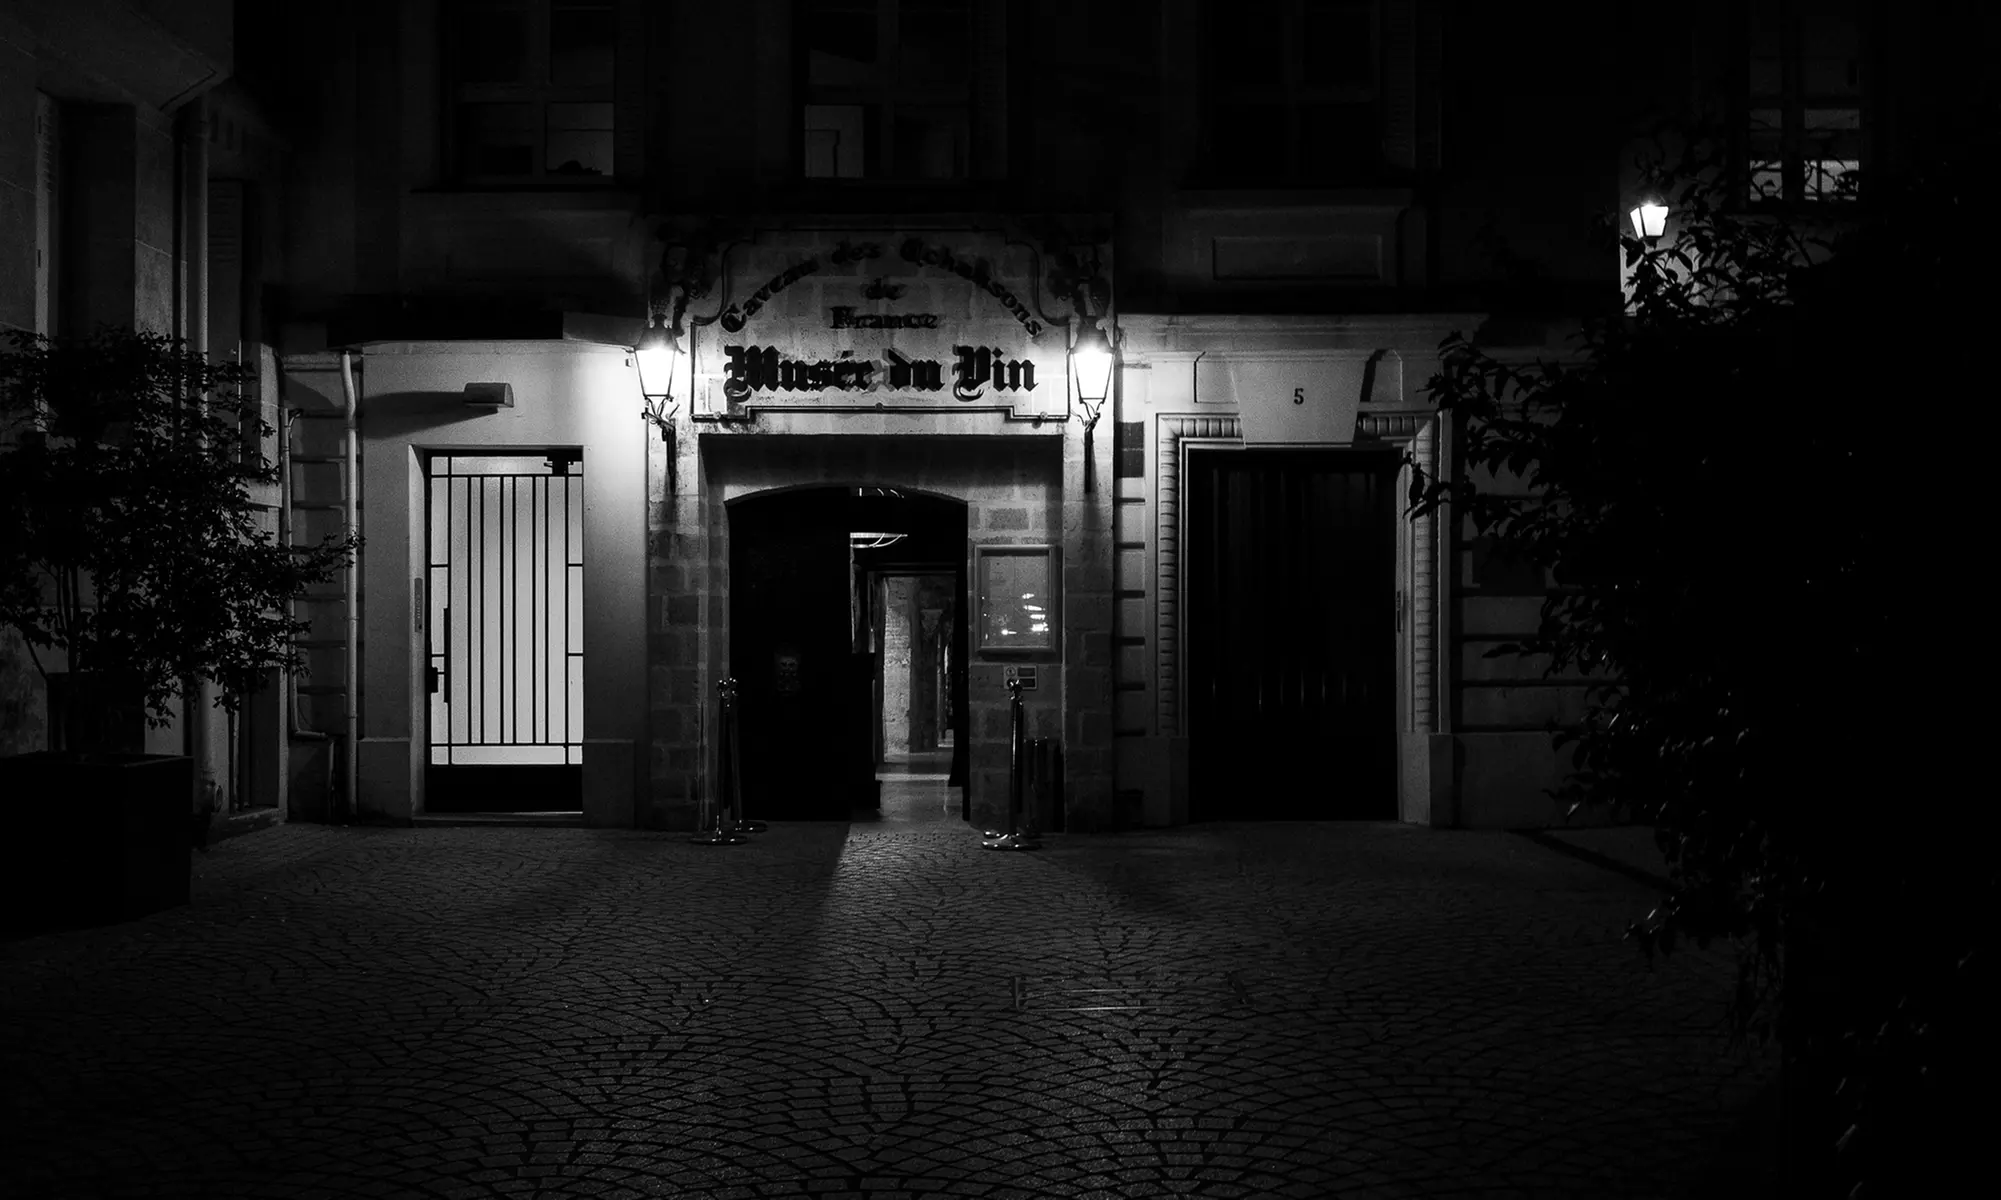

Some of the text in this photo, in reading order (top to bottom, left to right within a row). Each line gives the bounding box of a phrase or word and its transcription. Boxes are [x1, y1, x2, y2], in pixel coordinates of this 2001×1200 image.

[721, 259, 819, 333] Caveau
[832, 240, 881, 264] des
[865, 277, 901, 301] de
[829, 306, 938, 329] France
[724, 344, 1039, 402] Musée du Vin
[1294, 387, 1304, 405] 5
